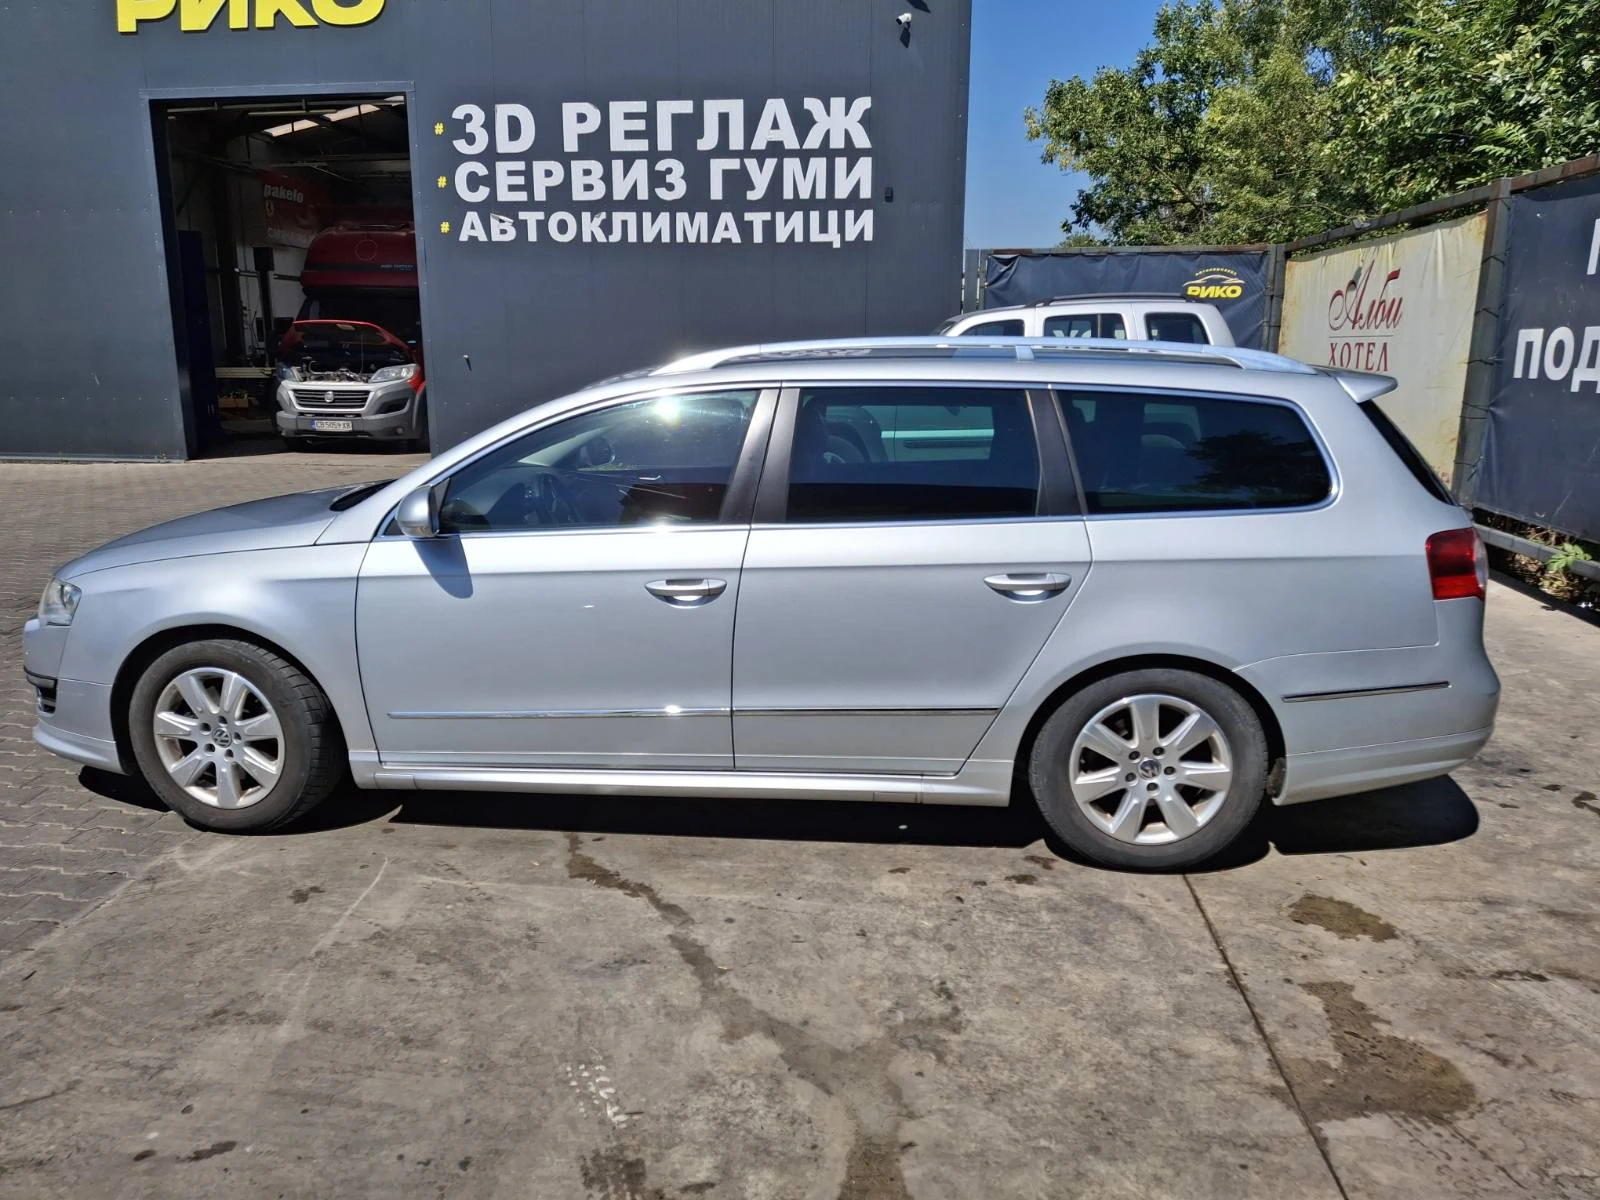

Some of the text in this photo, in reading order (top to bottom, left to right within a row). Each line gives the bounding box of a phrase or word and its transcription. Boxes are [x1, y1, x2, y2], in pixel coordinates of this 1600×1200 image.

[451, 103, 536, 155] 3D
[562, 96, 872, 153] РЕГЛАЖ
[454, 159, 688, 203] СЕРВИЗ
[709, 157, 872, 201] ГУМИ
[458, 209, 874, 248] АВТОКЛИМАТИЦИ
[1328, 342, 1388, 372] ХОТЕЛ
